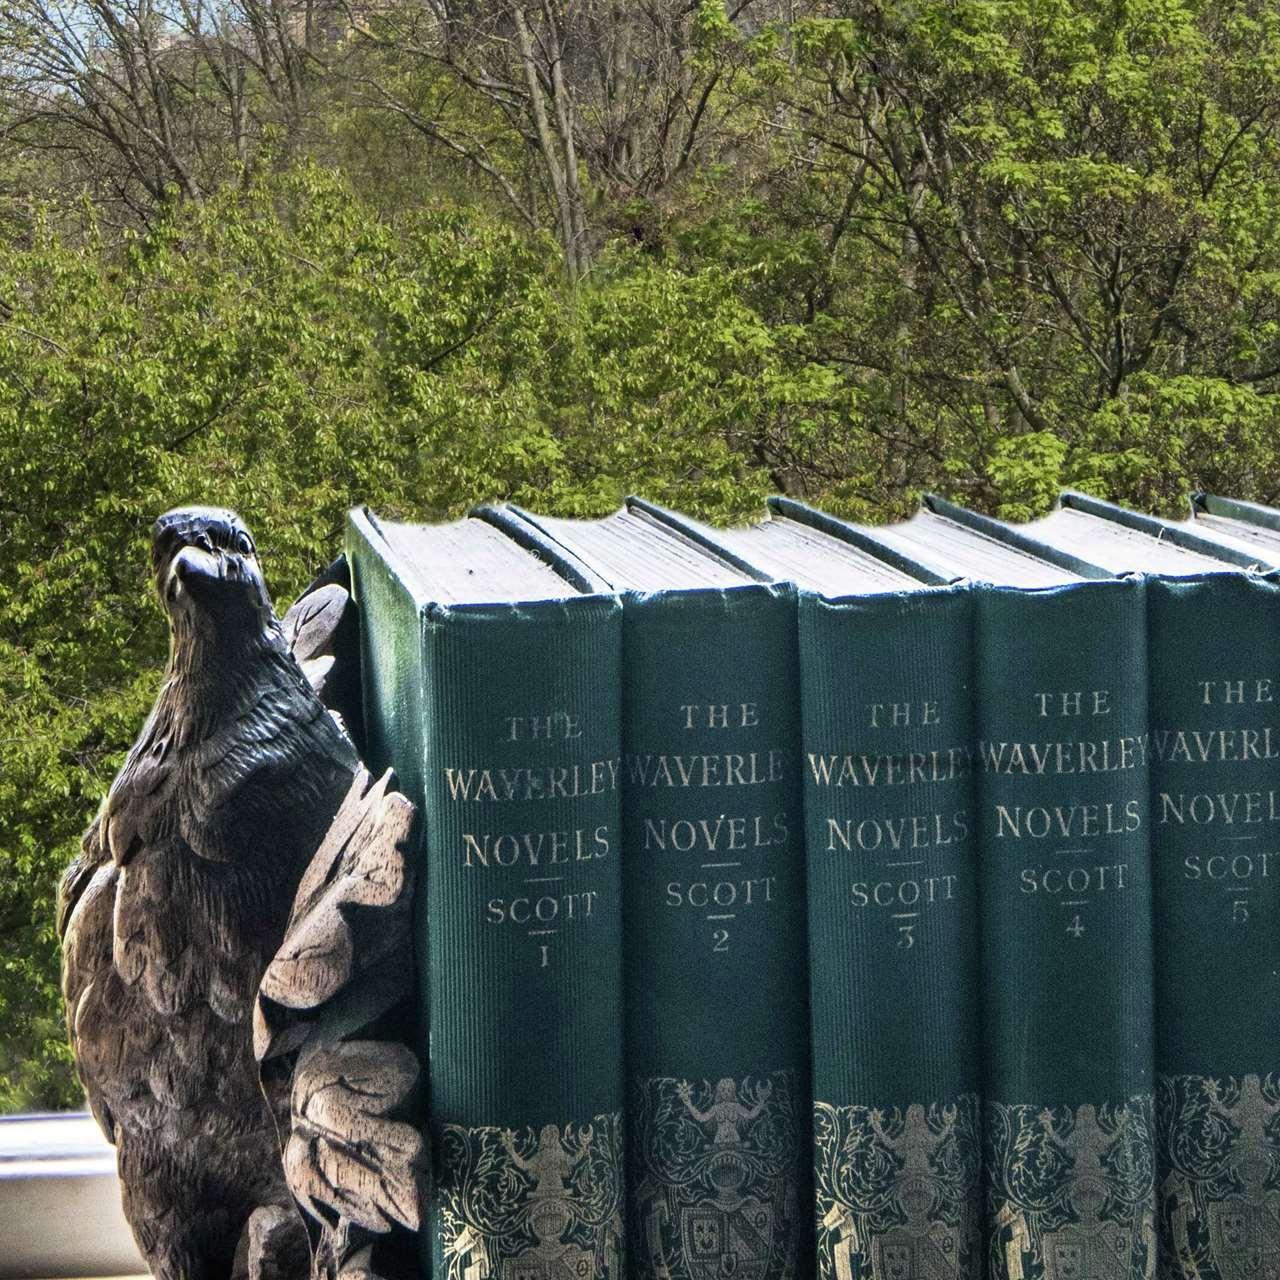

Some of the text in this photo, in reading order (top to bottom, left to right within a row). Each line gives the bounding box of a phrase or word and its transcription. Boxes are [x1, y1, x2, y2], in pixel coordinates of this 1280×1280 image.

[1035, 690, 1111, 717] THE
[1199, 679, 1273, 705] THE
[680, 702, 760, 730] THE
[870, 701, 941, 728] THE
[628, 750, 785, 787] WAVERLE
[644, 812, 789, 851] NOVELS
[827, 811, 968, 852] NOVELS
[995, 800, 1141, 839] NOVELS
[463, 826, 610, 868] NOVELS
[666, 877, 776, 907] SCOTT
[851, 875, 958, 907] SCOTT
[1020, 864, 1129, 893] SCOTT
[486, 891, 597, 924] SCOTT
[1233, 900, 1249, 922] 5
[713, 930, 729, 952] 2
[898, 926, 914, 949] 3
[1065, 915, 1085, 938] 4
